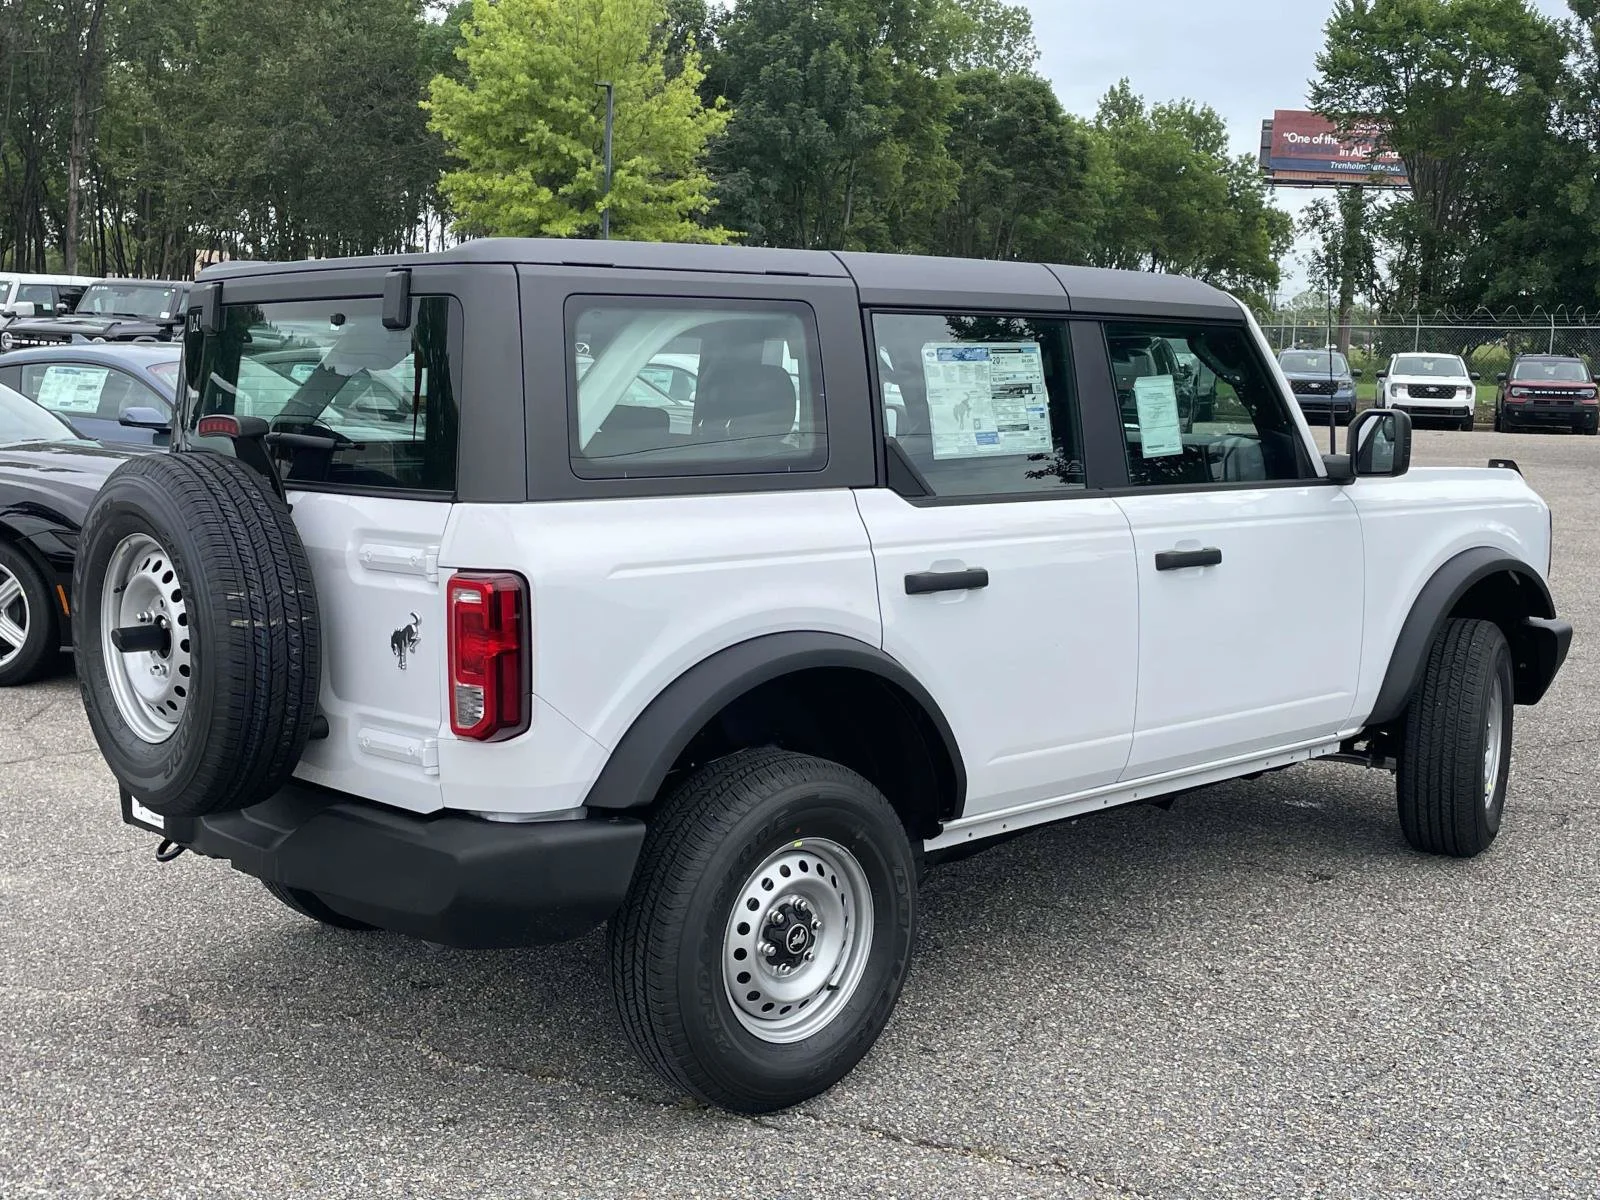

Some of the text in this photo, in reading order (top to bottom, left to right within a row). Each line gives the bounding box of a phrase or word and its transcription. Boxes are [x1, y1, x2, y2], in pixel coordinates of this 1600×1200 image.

[1312, 133, 1324, 144] of
[1324, 134, 1340, 144] the
[1340, 146, 1349, 156] in
